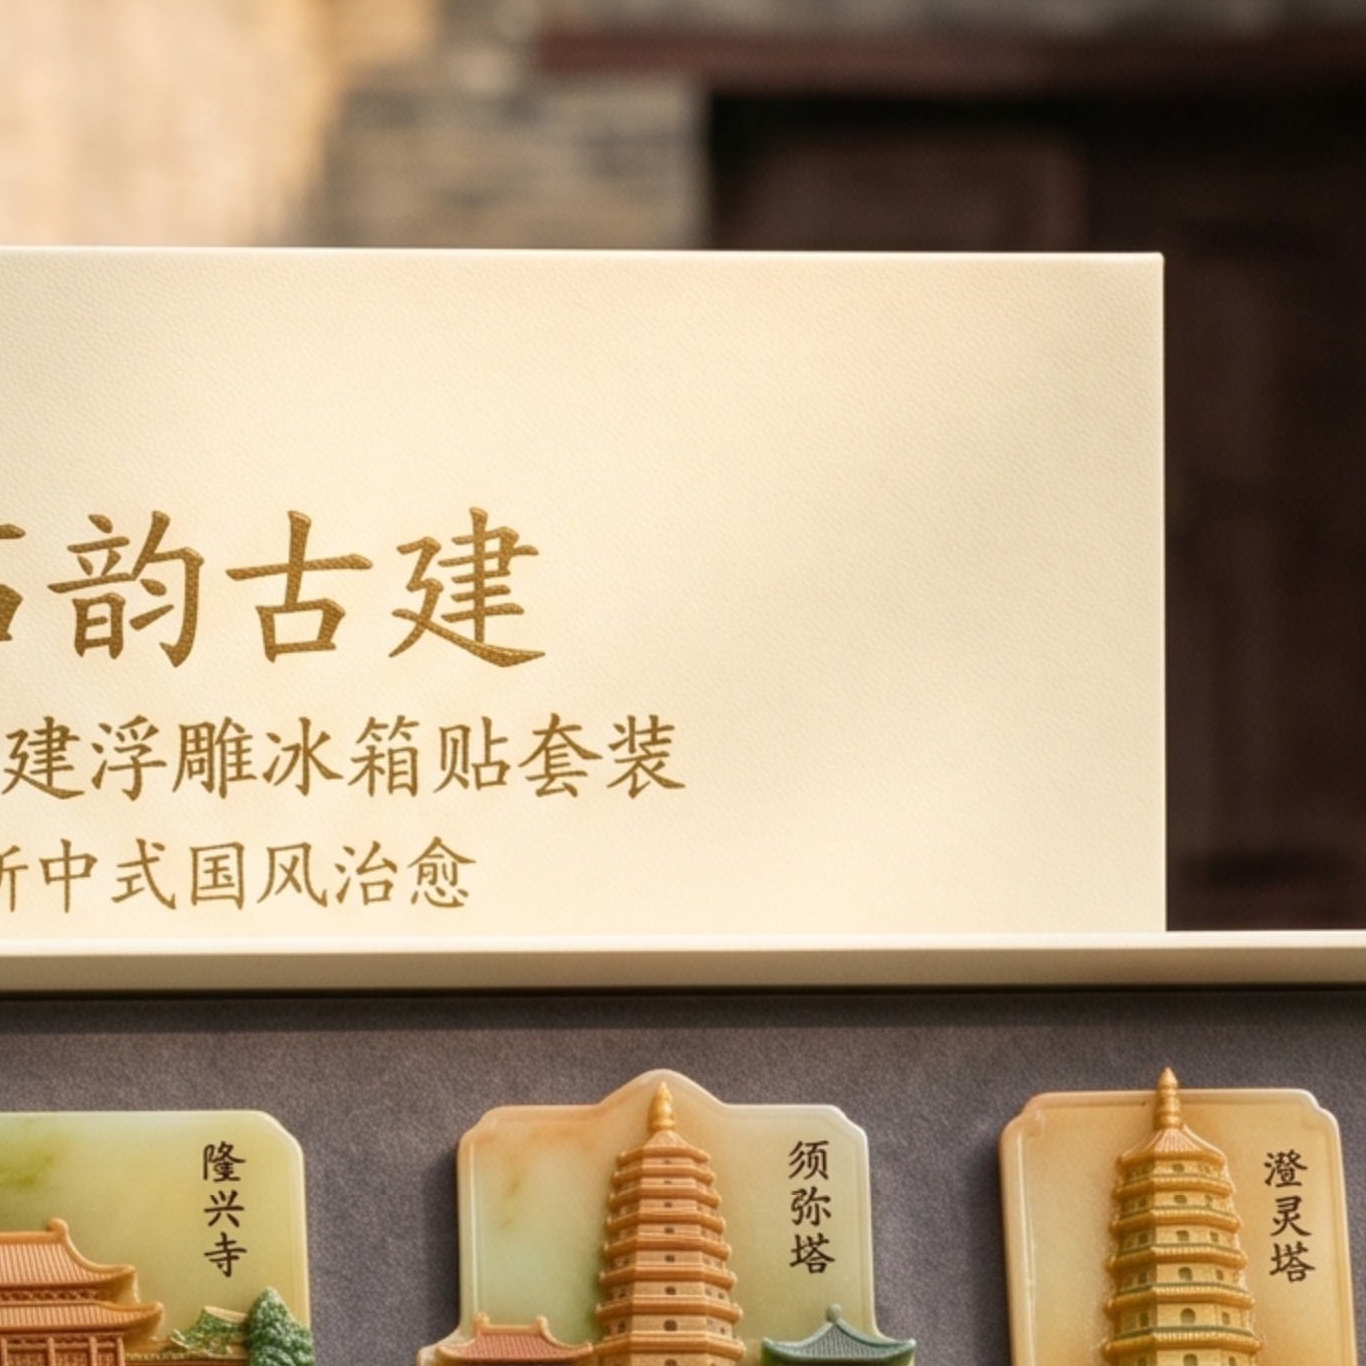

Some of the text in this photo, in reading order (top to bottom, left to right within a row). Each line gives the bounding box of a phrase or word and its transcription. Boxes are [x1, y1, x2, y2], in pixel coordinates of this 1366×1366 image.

[202, 1140, 248, 1279] 隆兴寺
[788, 1139, 836, 1275] 须弥塔
[1262, 1148, 1316, 1284] 澄灵塔
